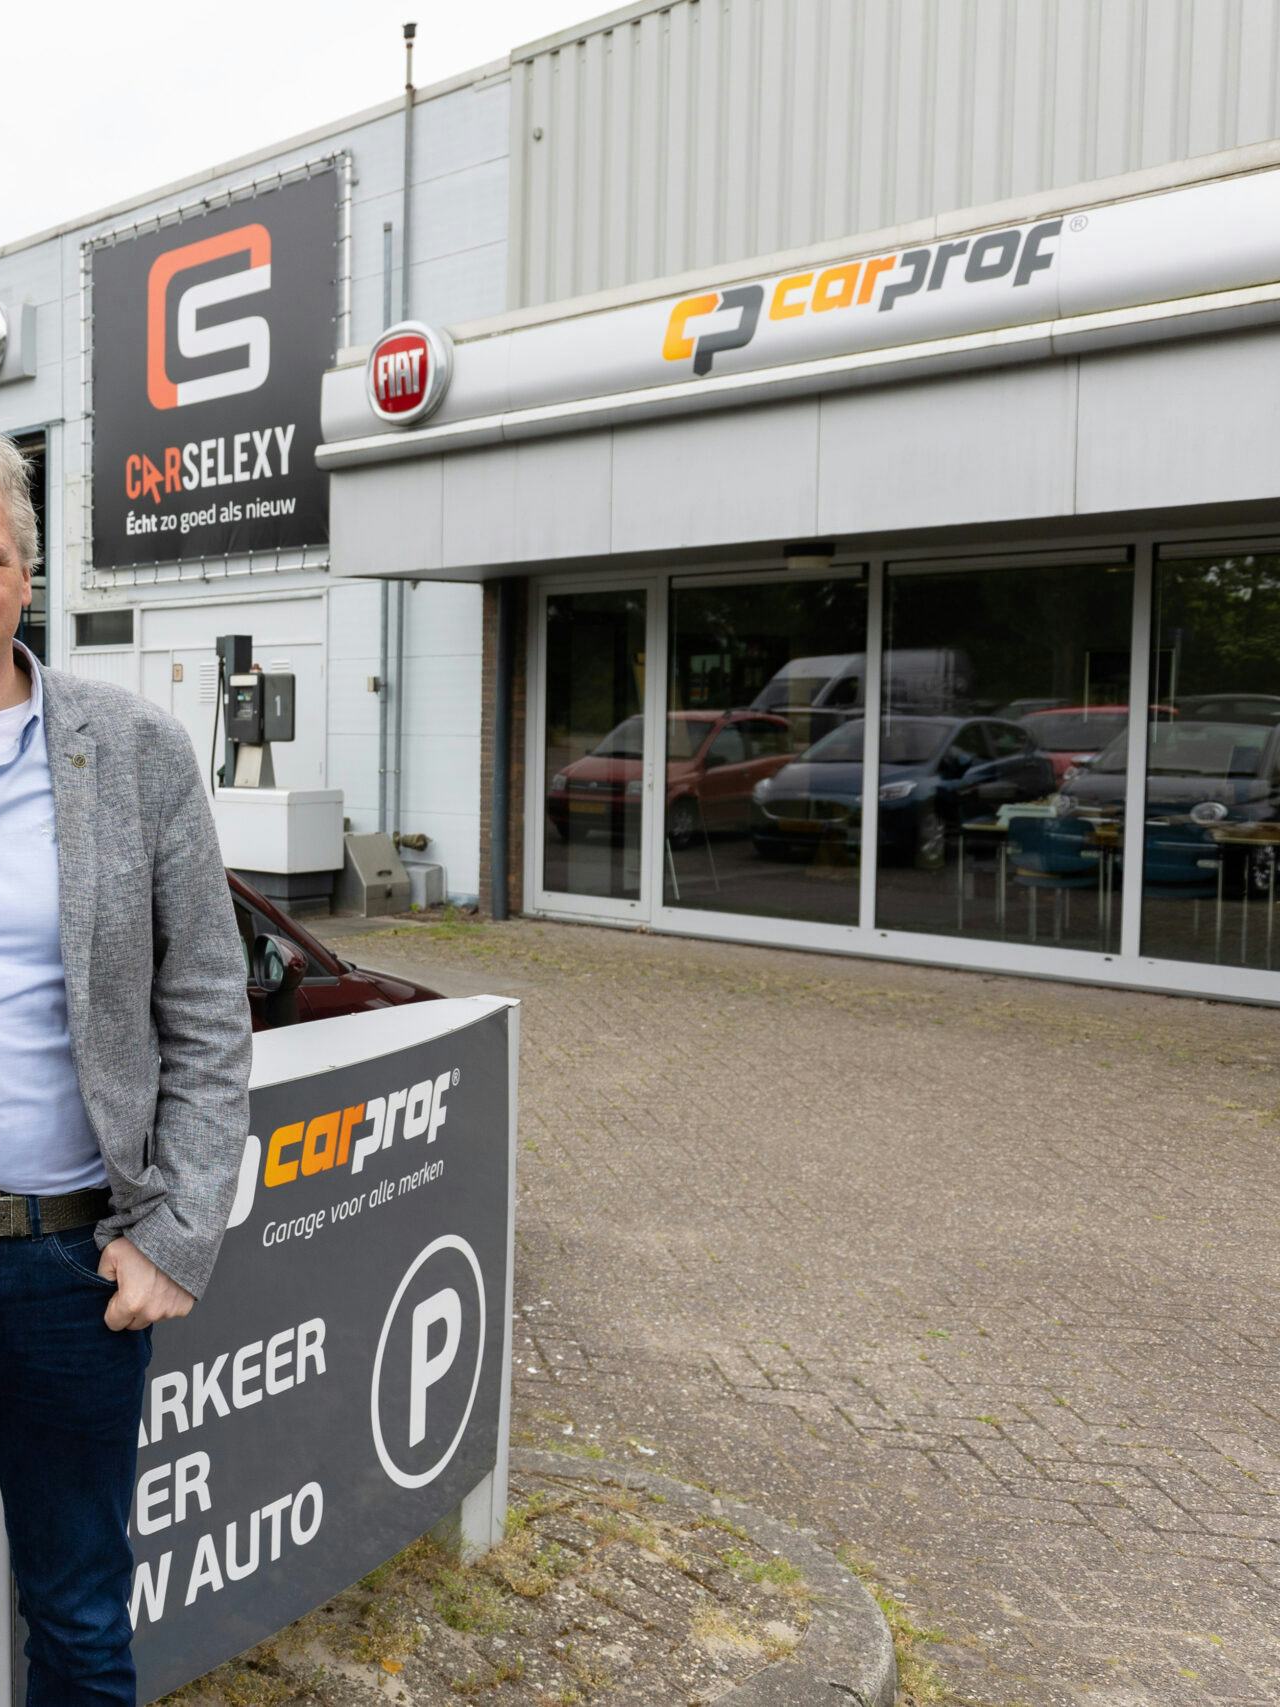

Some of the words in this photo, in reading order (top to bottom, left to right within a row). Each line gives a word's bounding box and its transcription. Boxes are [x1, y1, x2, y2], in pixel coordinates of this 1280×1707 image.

[768, 220, 1064, 321] carprof
[377, 347, 425, 400] FIAT
[126, 510, 158, 536] Écht
[160, 512, 178, 532] zo
[180, 503, 217, 534] goed
[219, 500, 243, 523] als
[246, 497, 297, 520] nieuw
[274, 694, 282, 717] 1
[263, 1070, 452, 1188] carprof
[262, 1209, 326, 1247] Garage
[330, 1193, 366, 1224] voor
[369, 1179, 394, 1208] alle
[398, 1159, 444, 1196] merken
[137, 1317, 327, 1448] RKEER
[409, 1287, 462, 1448] P
[185, 1481, 324, 1607] AUTO
